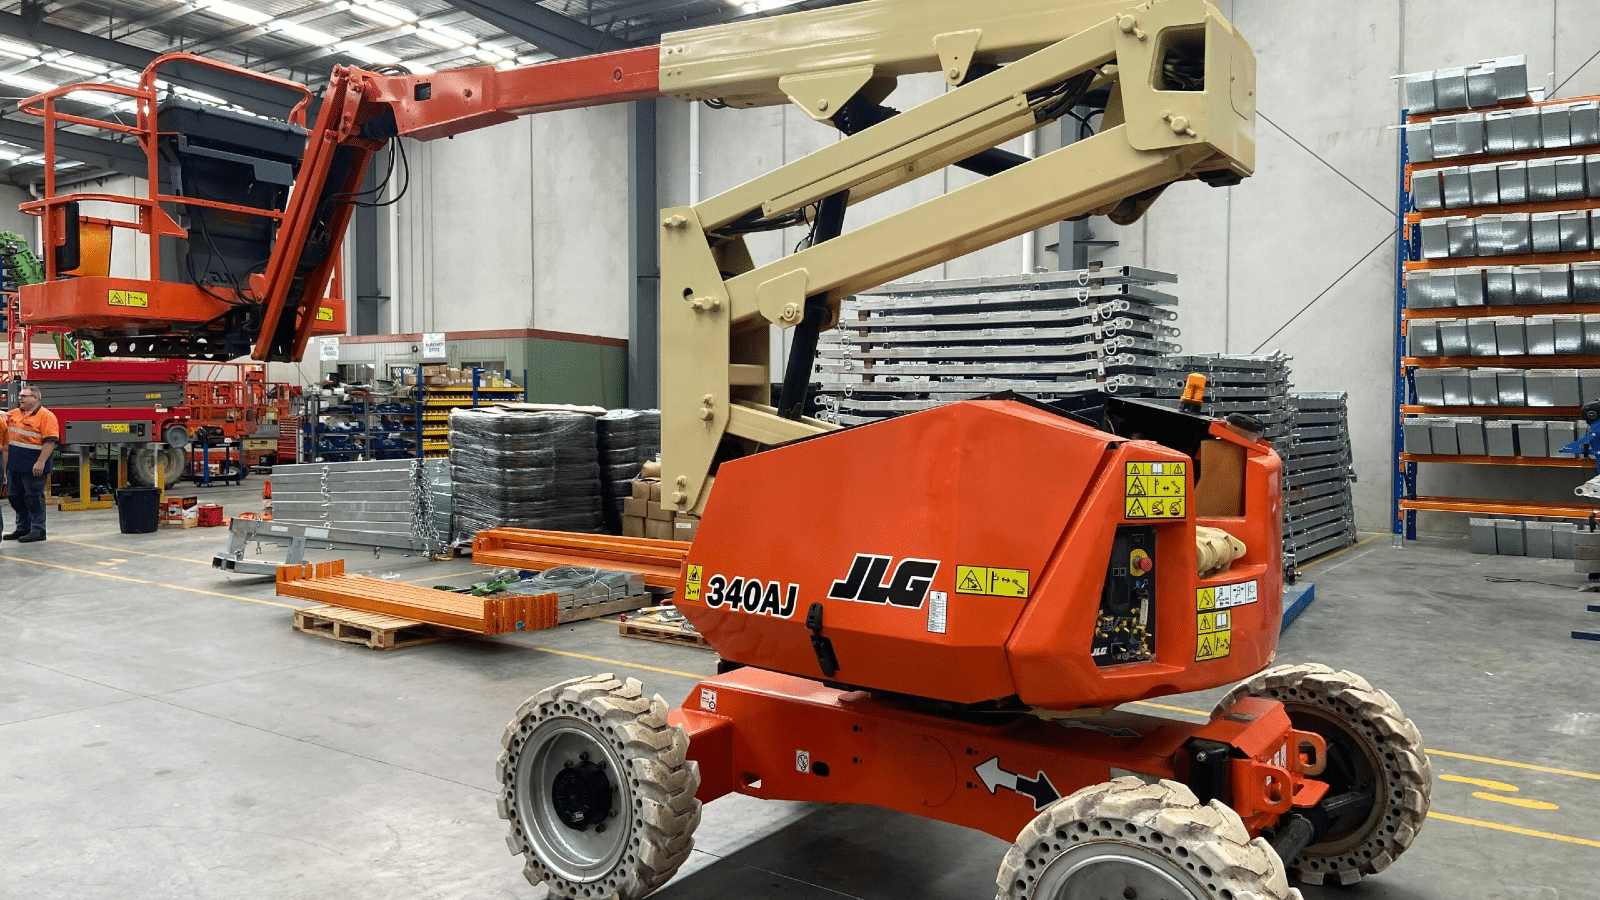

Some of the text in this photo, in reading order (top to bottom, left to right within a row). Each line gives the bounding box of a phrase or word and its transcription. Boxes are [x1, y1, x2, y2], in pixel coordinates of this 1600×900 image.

[32, 361, 72, 370] SWIFT
[827, 553, 942, 610] JLG
[705, 574, 800, 619] 340AJ
[1091, 646, 1108, 656] JLG
